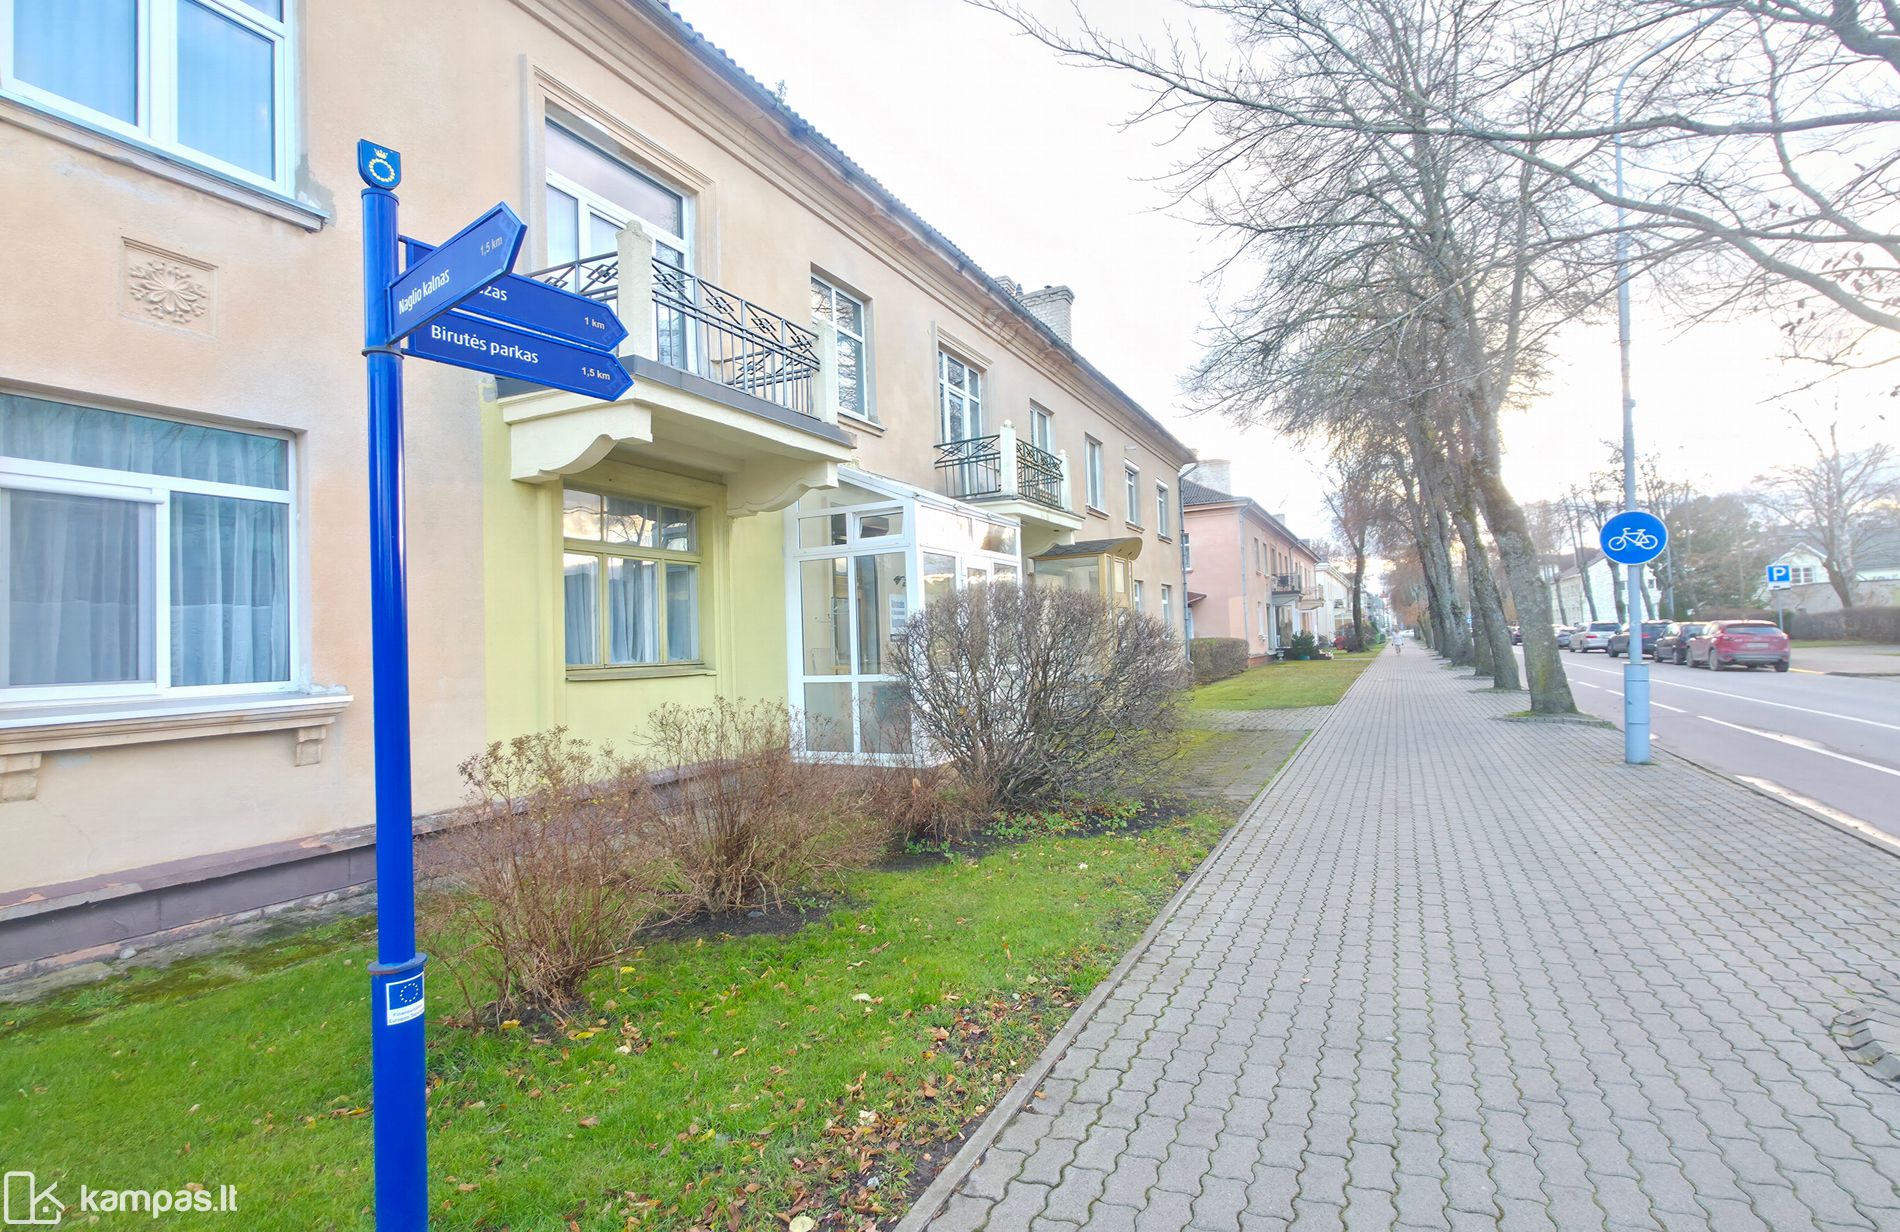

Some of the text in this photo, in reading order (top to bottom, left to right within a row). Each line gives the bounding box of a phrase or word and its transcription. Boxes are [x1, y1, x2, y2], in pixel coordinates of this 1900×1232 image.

[480, 236, 503, 256] 1,5 km
[399, 269, 450, 315] Naglio kalnas
[584, 317, 605, 330] 1 km
[431, 324, 539, 364] Birutės parkas
[582, 367, 611, 381] 1,5 km
[1773, 567, 1786, 580] P
